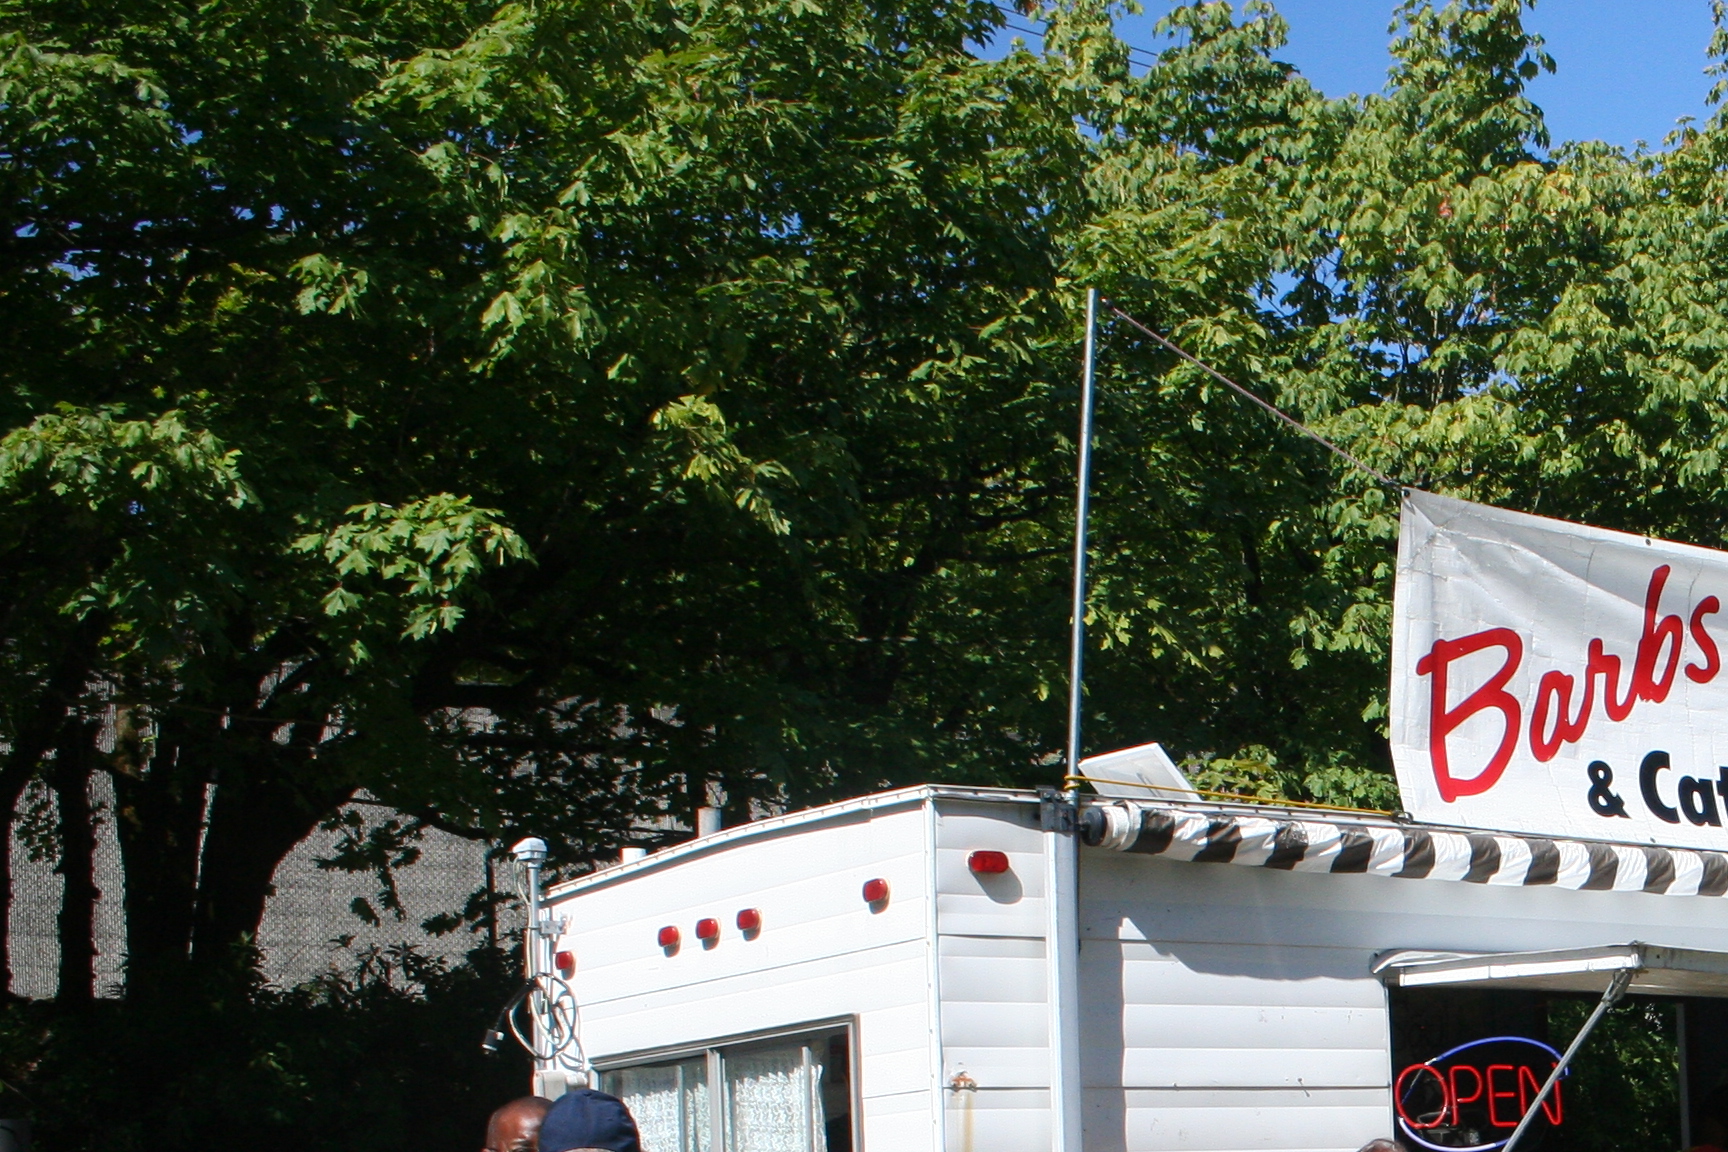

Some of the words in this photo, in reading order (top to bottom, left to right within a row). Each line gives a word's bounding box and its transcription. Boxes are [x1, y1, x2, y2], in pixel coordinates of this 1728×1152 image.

[1416, 564, 1721, 802] Barbs
[1586, 760, 1629, 818] &
[1395, 1063, 1562, 1130] OPEN
